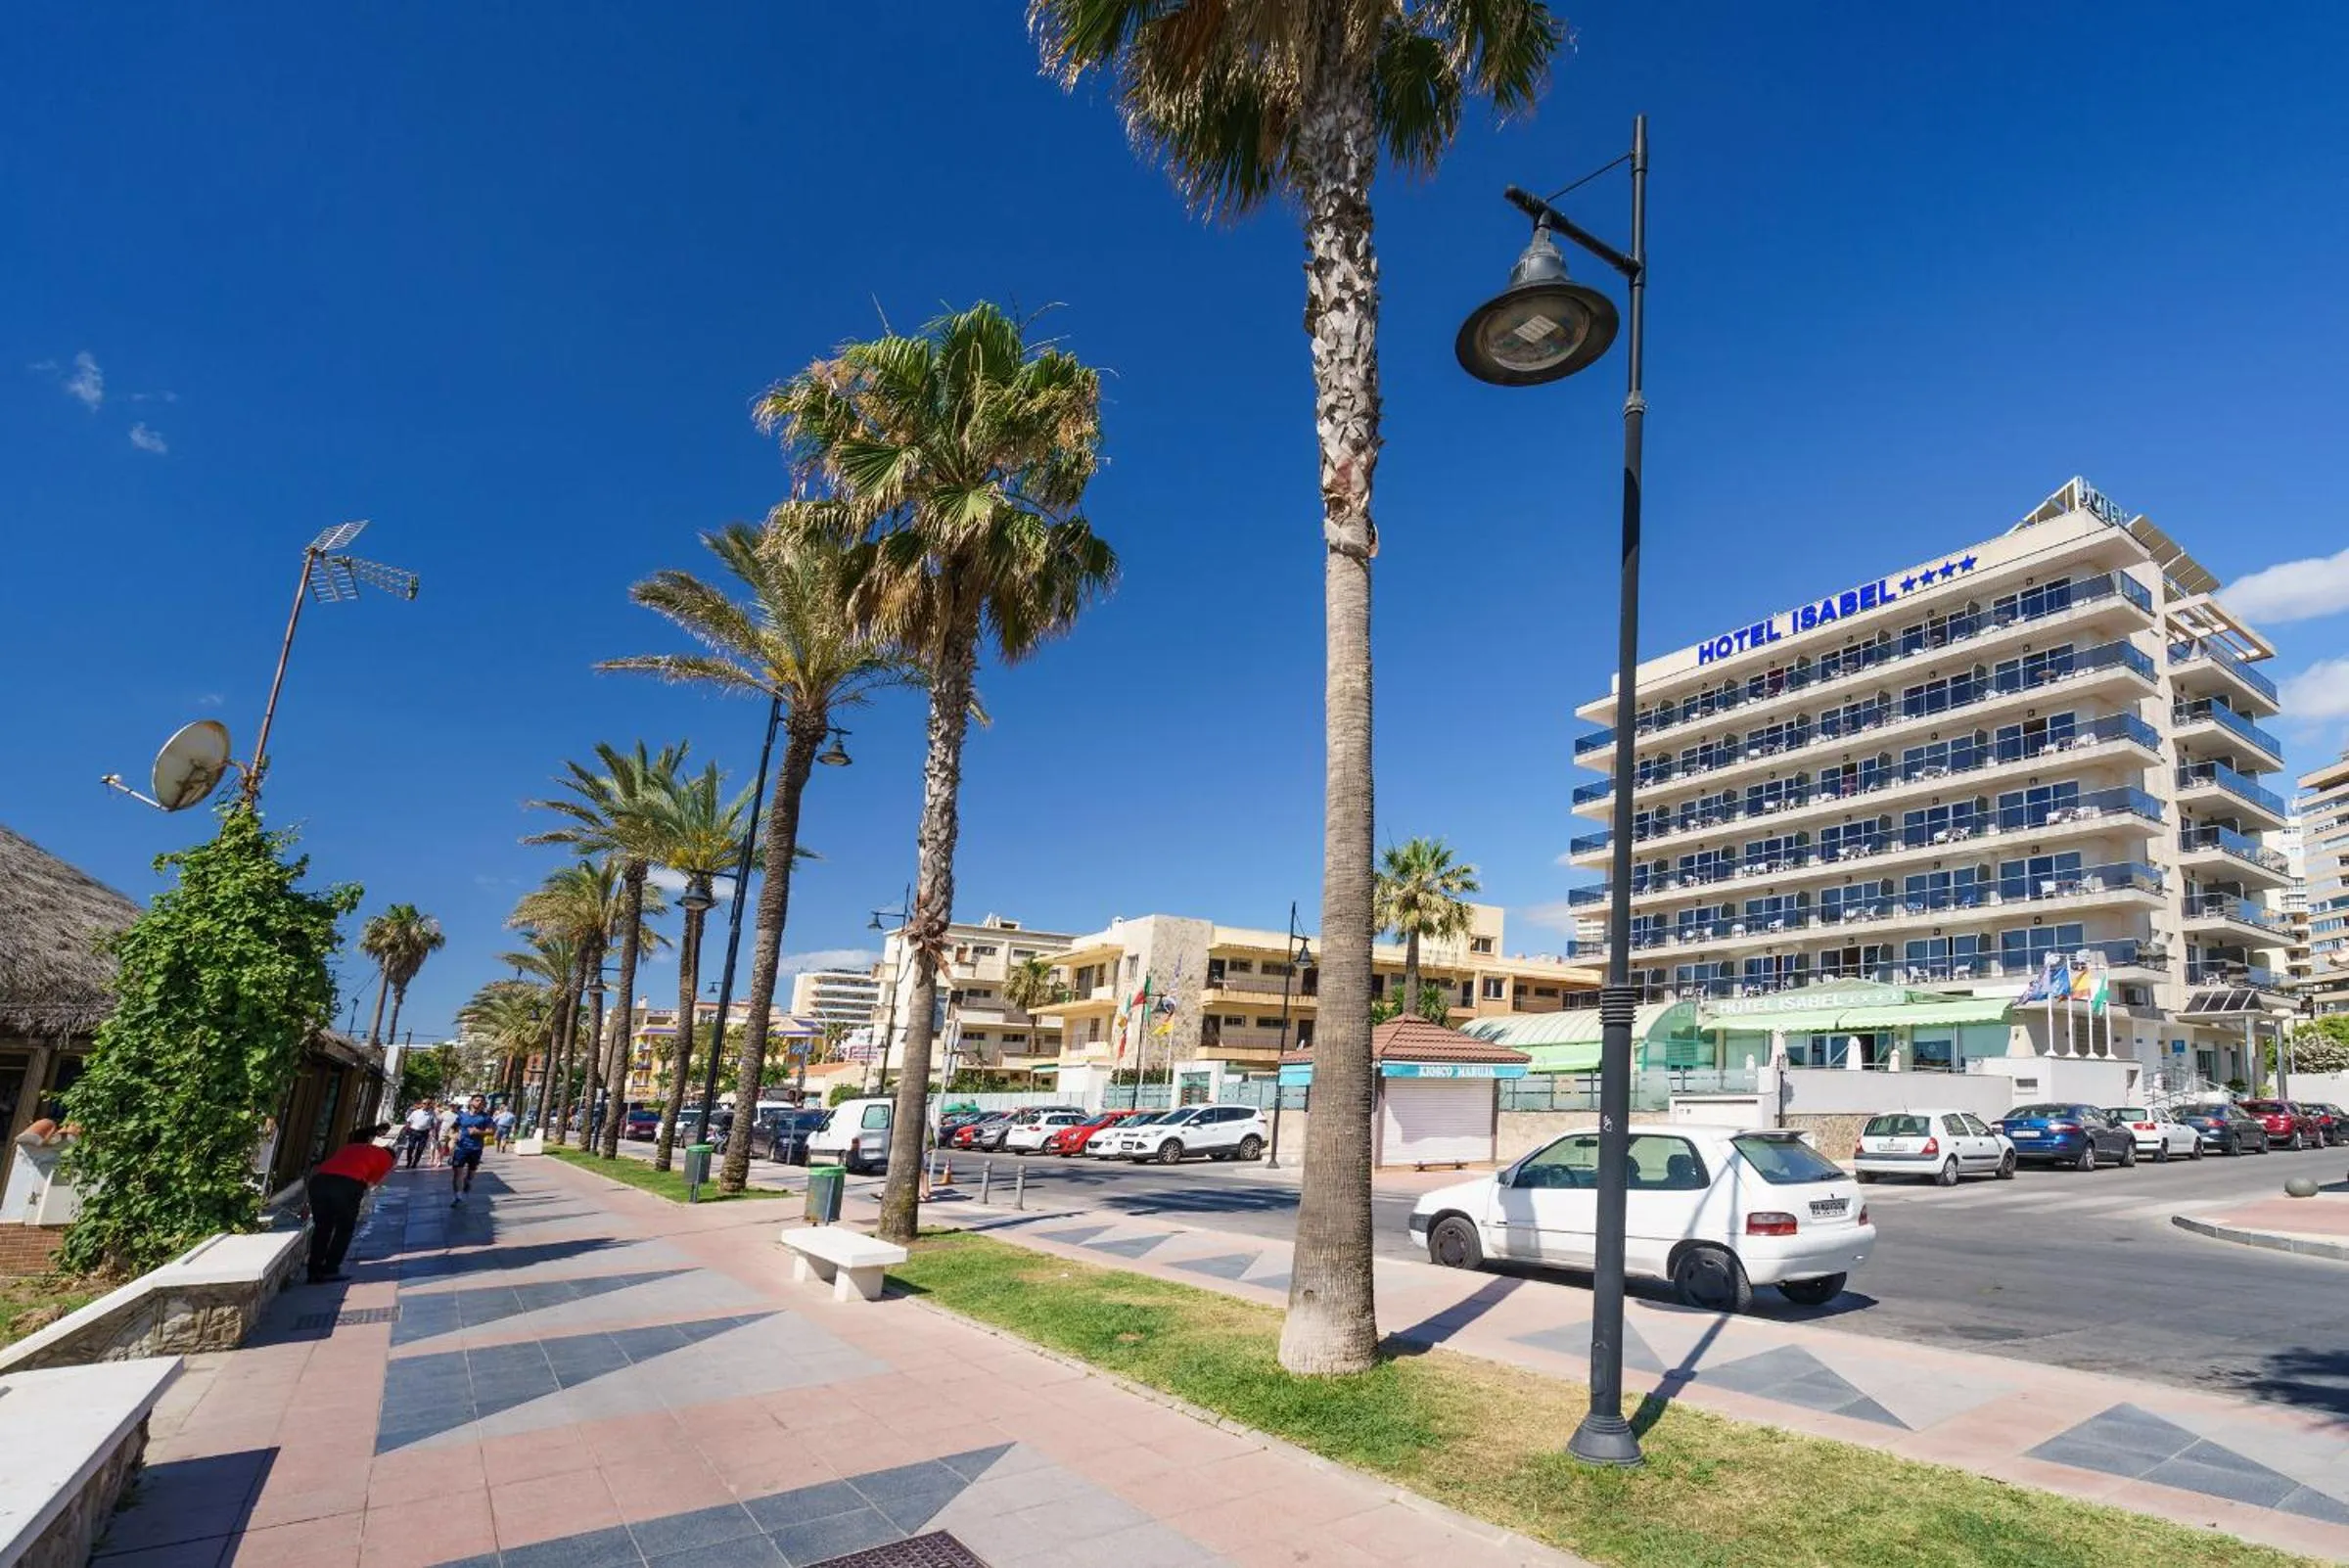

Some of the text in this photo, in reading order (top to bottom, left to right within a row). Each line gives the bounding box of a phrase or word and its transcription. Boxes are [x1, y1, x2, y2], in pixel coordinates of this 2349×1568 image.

[1698, 579, 1897, 666] HOTEL ISABEL
[1720, 992, 1843, 1014] HOTEL ISABEL
